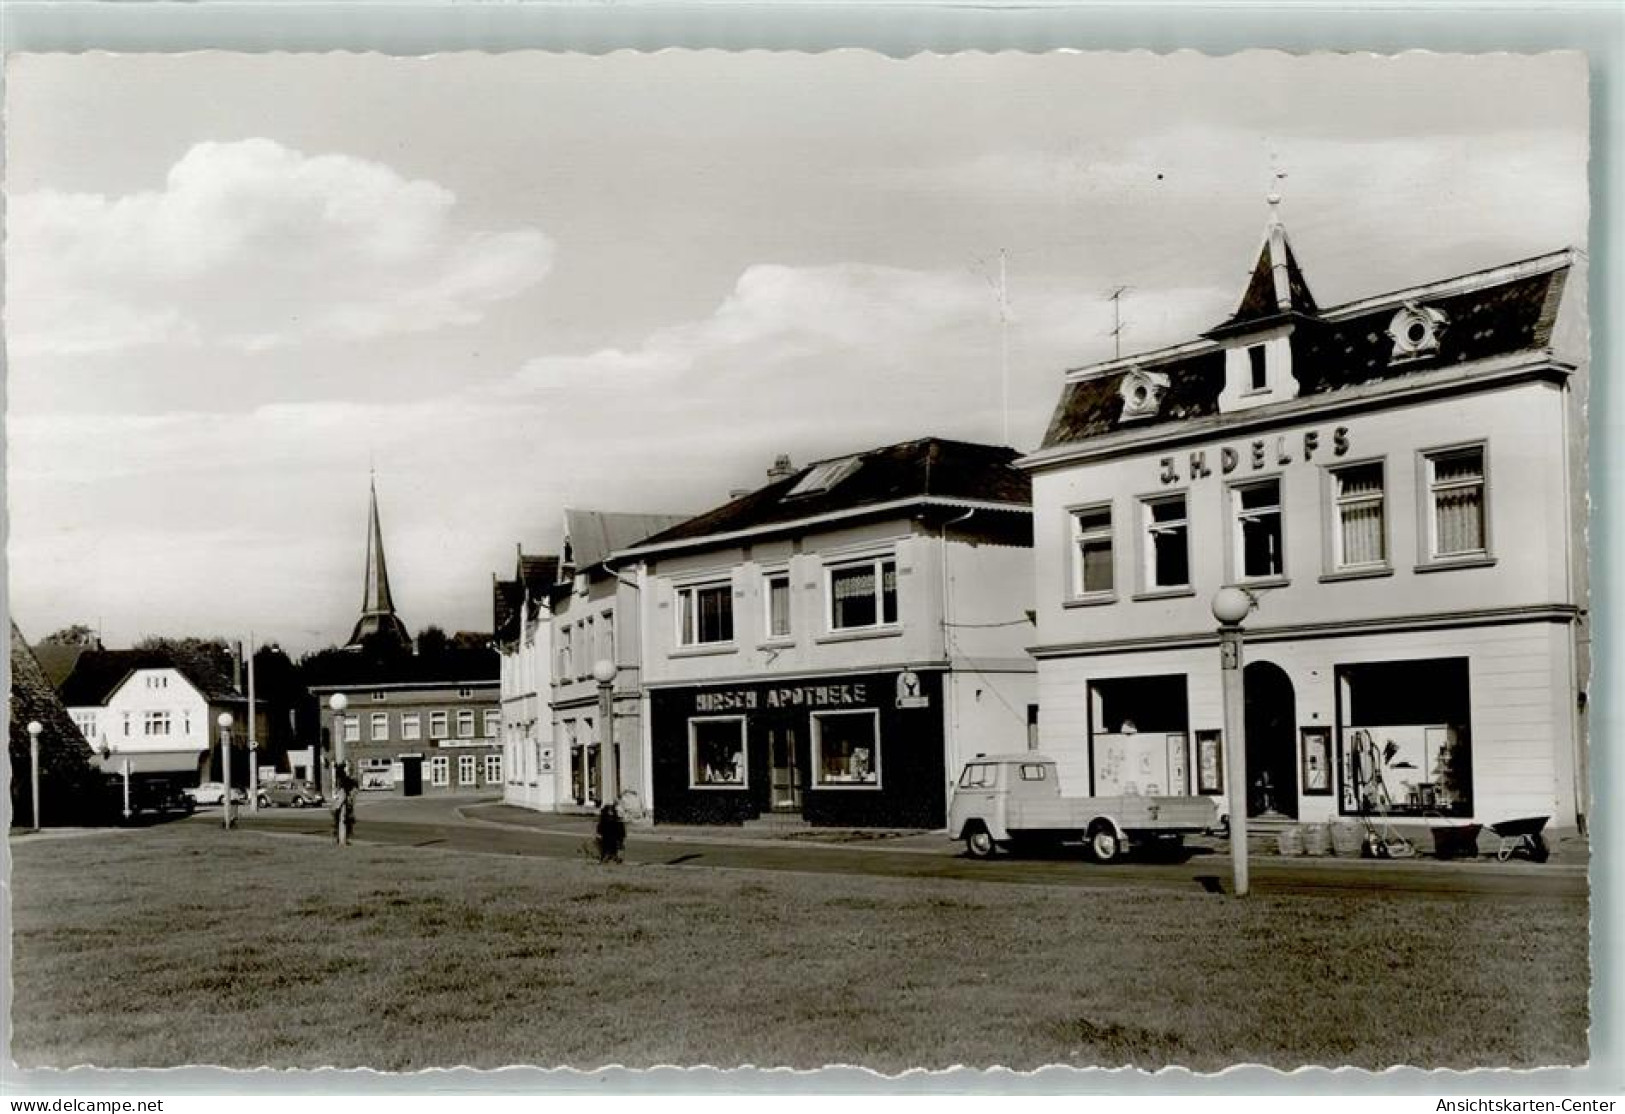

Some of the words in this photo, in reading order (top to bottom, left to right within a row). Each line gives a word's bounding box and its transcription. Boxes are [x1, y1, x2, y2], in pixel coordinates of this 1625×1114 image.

[1221, 426, 1350, 474] DELFS
[696, 691, 758, 711] HIRSCH
[766, 684, 867, 709] APOTHEKE
